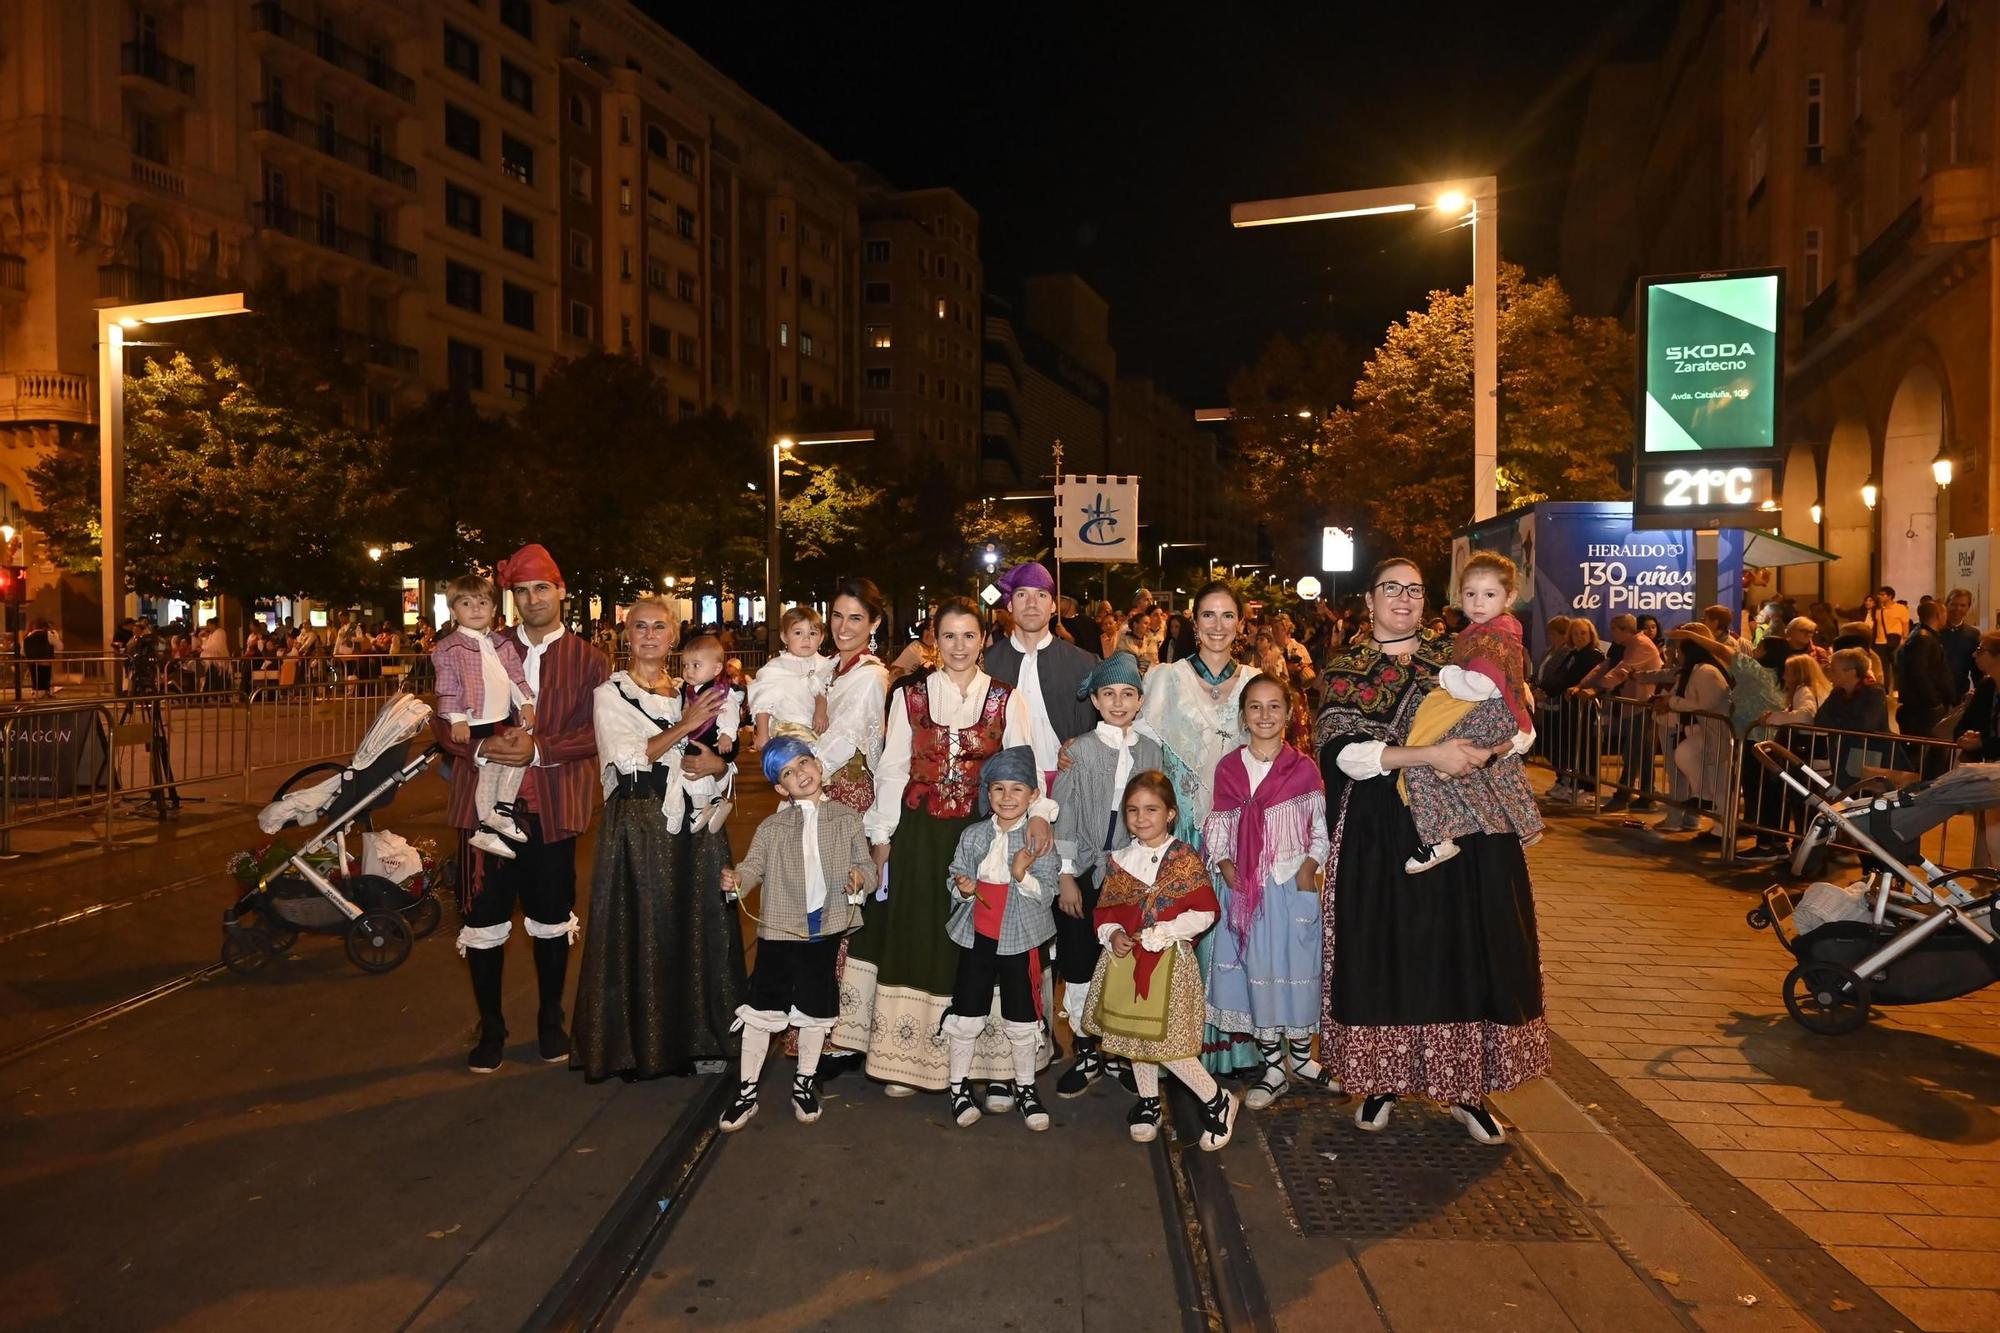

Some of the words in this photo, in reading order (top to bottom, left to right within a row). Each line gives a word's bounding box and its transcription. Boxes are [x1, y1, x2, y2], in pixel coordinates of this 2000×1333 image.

[1674, 360, 1747, 373] Zaratecno
[1694, 390, 1732, 399] Cataluña,
[1587, 544, 1665, 557] HERALDO
[1579, 561, 1627, 585] 130
[1636, 565, 1693, 586] años
[1572, 586, 1602, 609] de
[1609, 585, 1694, 610] Pilares
